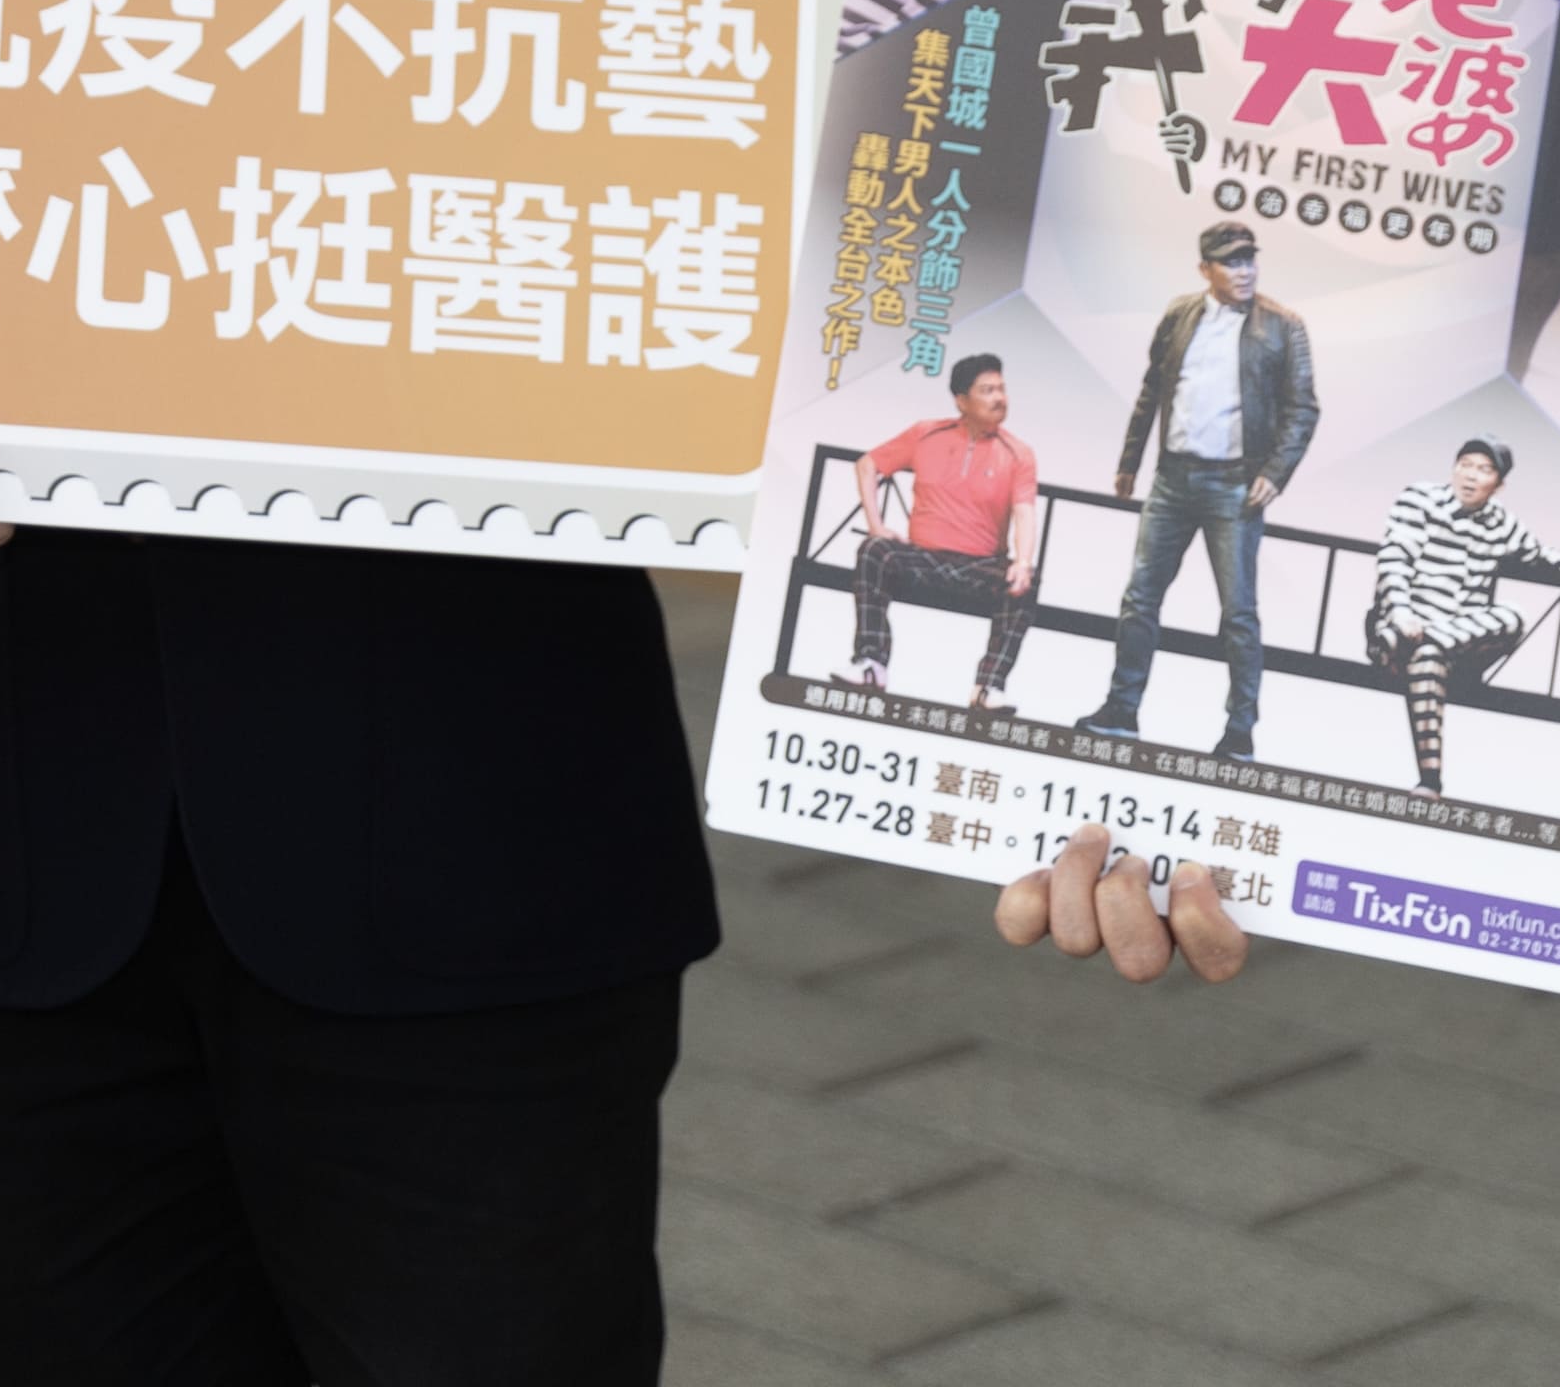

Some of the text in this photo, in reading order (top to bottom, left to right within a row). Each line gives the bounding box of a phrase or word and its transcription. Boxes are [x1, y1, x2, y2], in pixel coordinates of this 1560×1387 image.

[870, 28, 951, 326] 集天下男人之本色
[901, 5, 1001, 377] 曾國城一人分飾三角
[1220, 137, 1505, 216] MY FIRST WIVES
[757, 778, 916, 837] 11.27-28
[765, 730, 921, 788] 10.30-31
[1040, 782, 1201, 842] 11.13-14
[1211, 815, 1283, 857] 高雄
